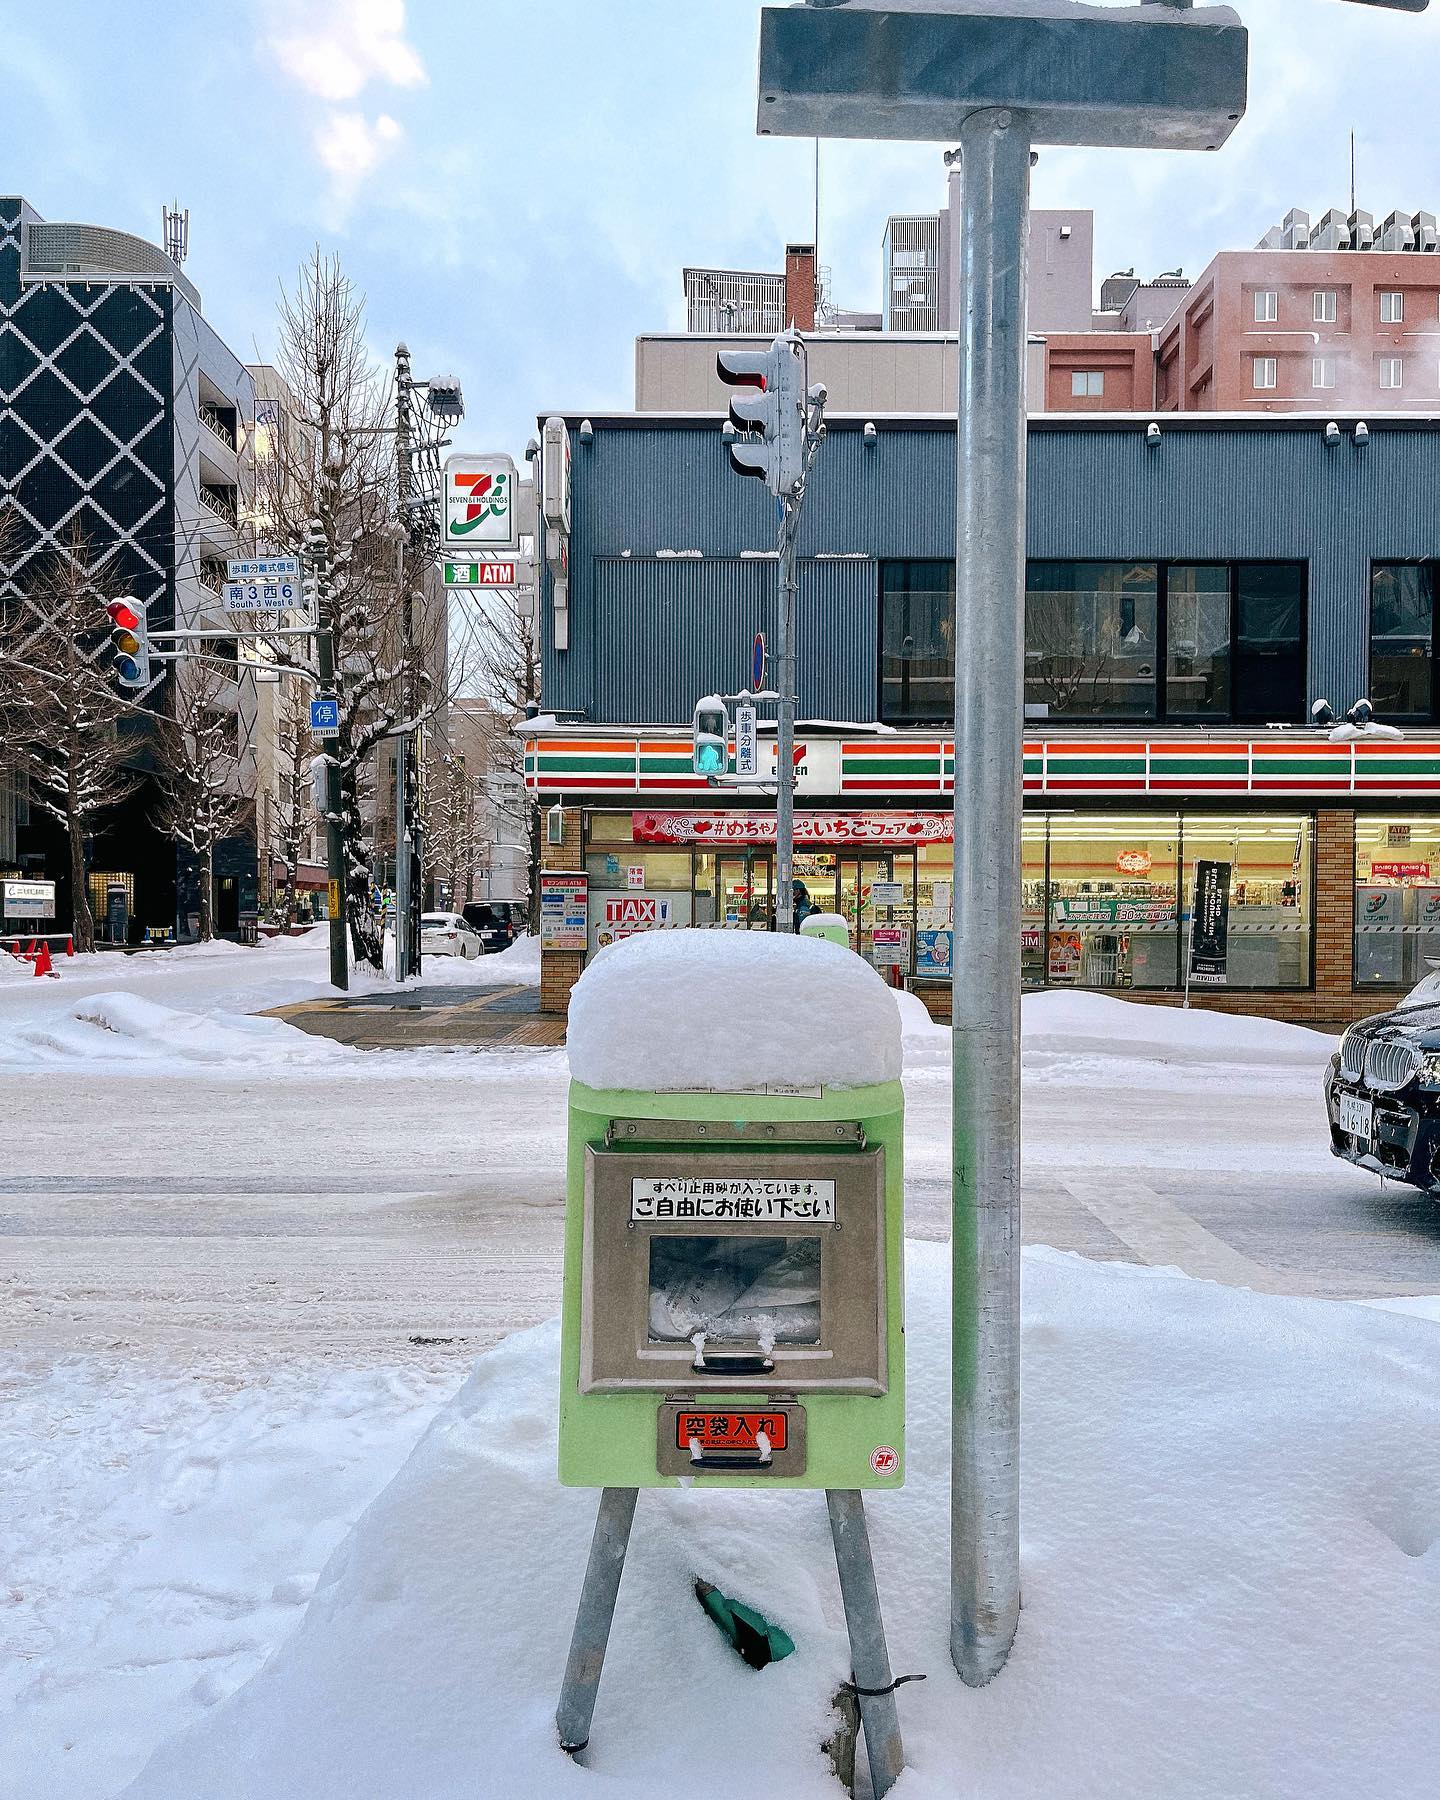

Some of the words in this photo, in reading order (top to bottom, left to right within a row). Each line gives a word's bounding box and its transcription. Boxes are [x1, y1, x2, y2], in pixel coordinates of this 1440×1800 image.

[231, 563, 295, 575] 歩車分離式信号
[453, 565, 471, 582] 酒
[483, 565, 511, 582] ATM
[230, 600, 253, 609] South
[256, 600, 262, 608] 3
[264, 598, 285, 607] West
[288, 598, 293, 607] 6
[315, 705, 334, 723] 停
[740, 711, 752, 771] 歩車分離式
[1391, 826, 1408, 834] ATM
[606, 901, 656, 921] TAX
[652, 1182, 818, 1196] すべり止用砂が入っています。
[635, 1196, 831, 1218] ご自由にお使い下さい
[686, 1416, 777, 1438] 空袋入れ
